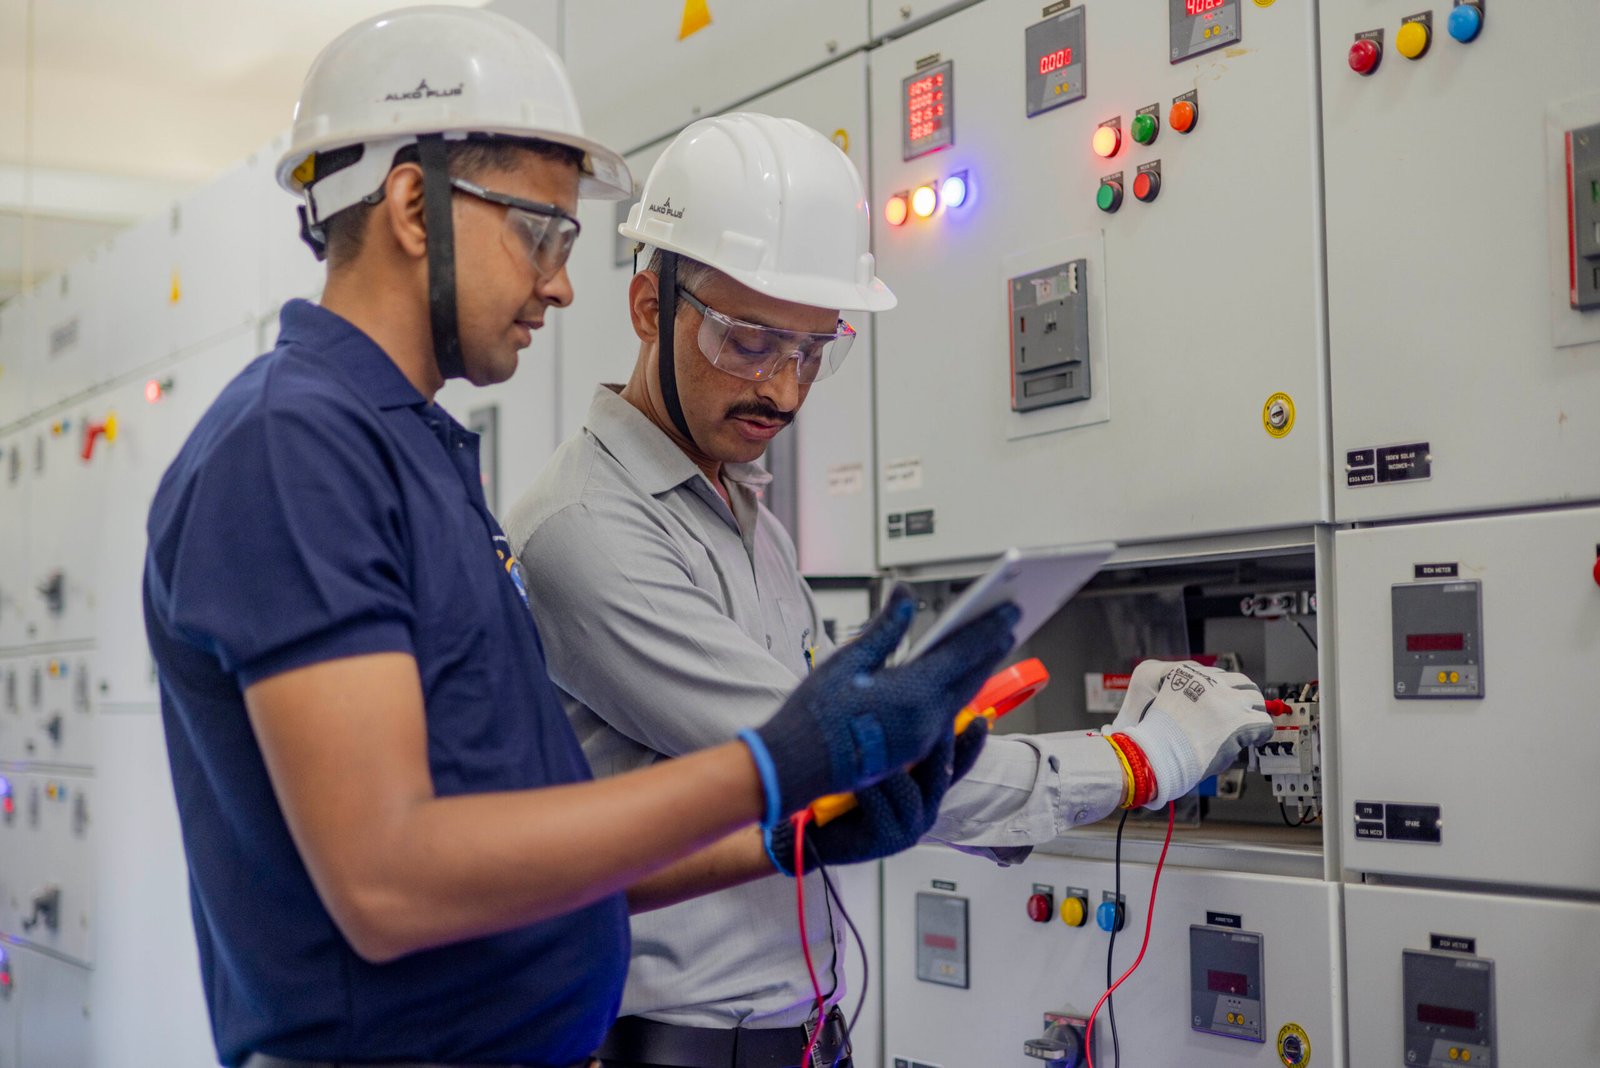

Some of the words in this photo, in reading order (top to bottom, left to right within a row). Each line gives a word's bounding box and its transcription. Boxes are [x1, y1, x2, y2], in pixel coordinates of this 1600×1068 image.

[384, 91, 422, 101] ALKO
[427, 88, 462, 98] PLUS
[648, 204, 666, 214] ALKO
[666, 208, 683, 219] PLUS
